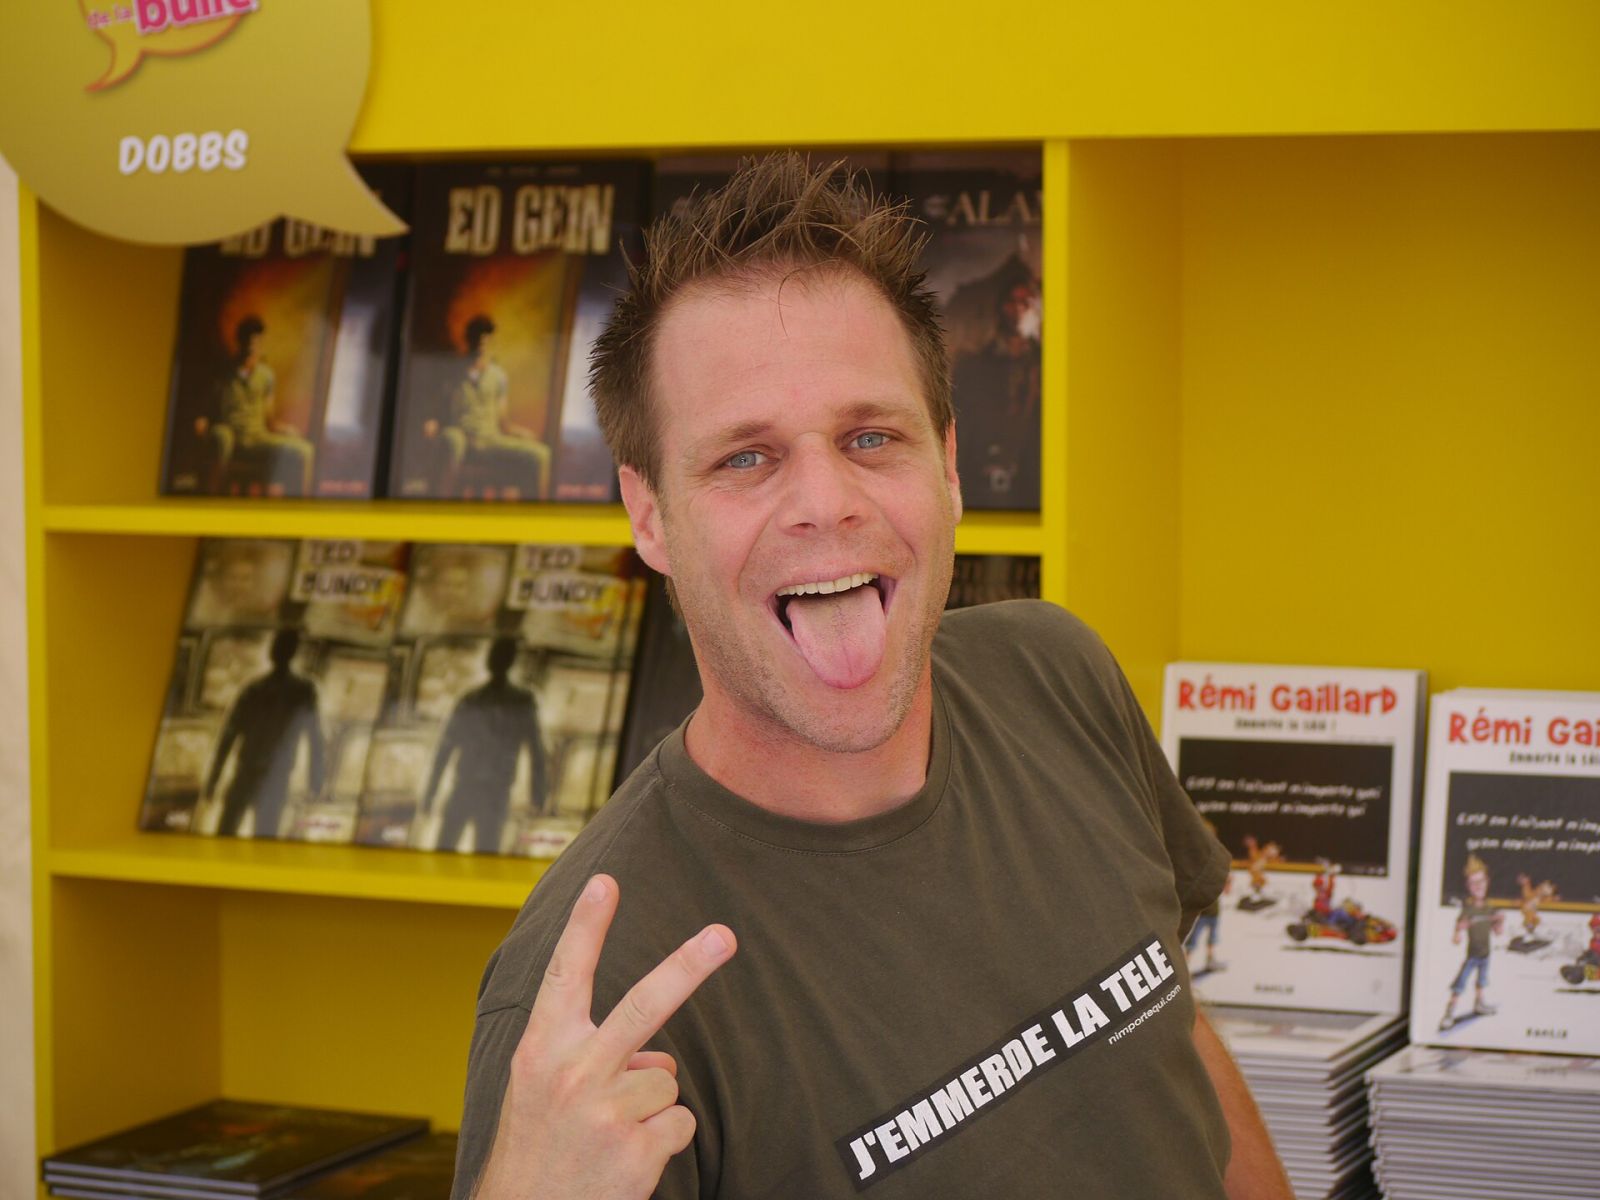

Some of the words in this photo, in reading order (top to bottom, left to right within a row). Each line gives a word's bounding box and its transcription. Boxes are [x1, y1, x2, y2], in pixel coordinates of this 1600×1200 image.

[118, 129, 249, 175] DOBBS
[445, 186, 501, 255] ED
[513, 184, 614, 254] GEIN
[1178, 675, 1255, 711] Rémi
[1449, 707, 1532, 745] Rémi
[1108, 984, 1182, 1045] nimportequi.com
[850, 1023, 1056, 1180] J'EMMERDE
[1051, 993, 1110, 1048] LA
[1099, 940, 1174, 1012] TELE
